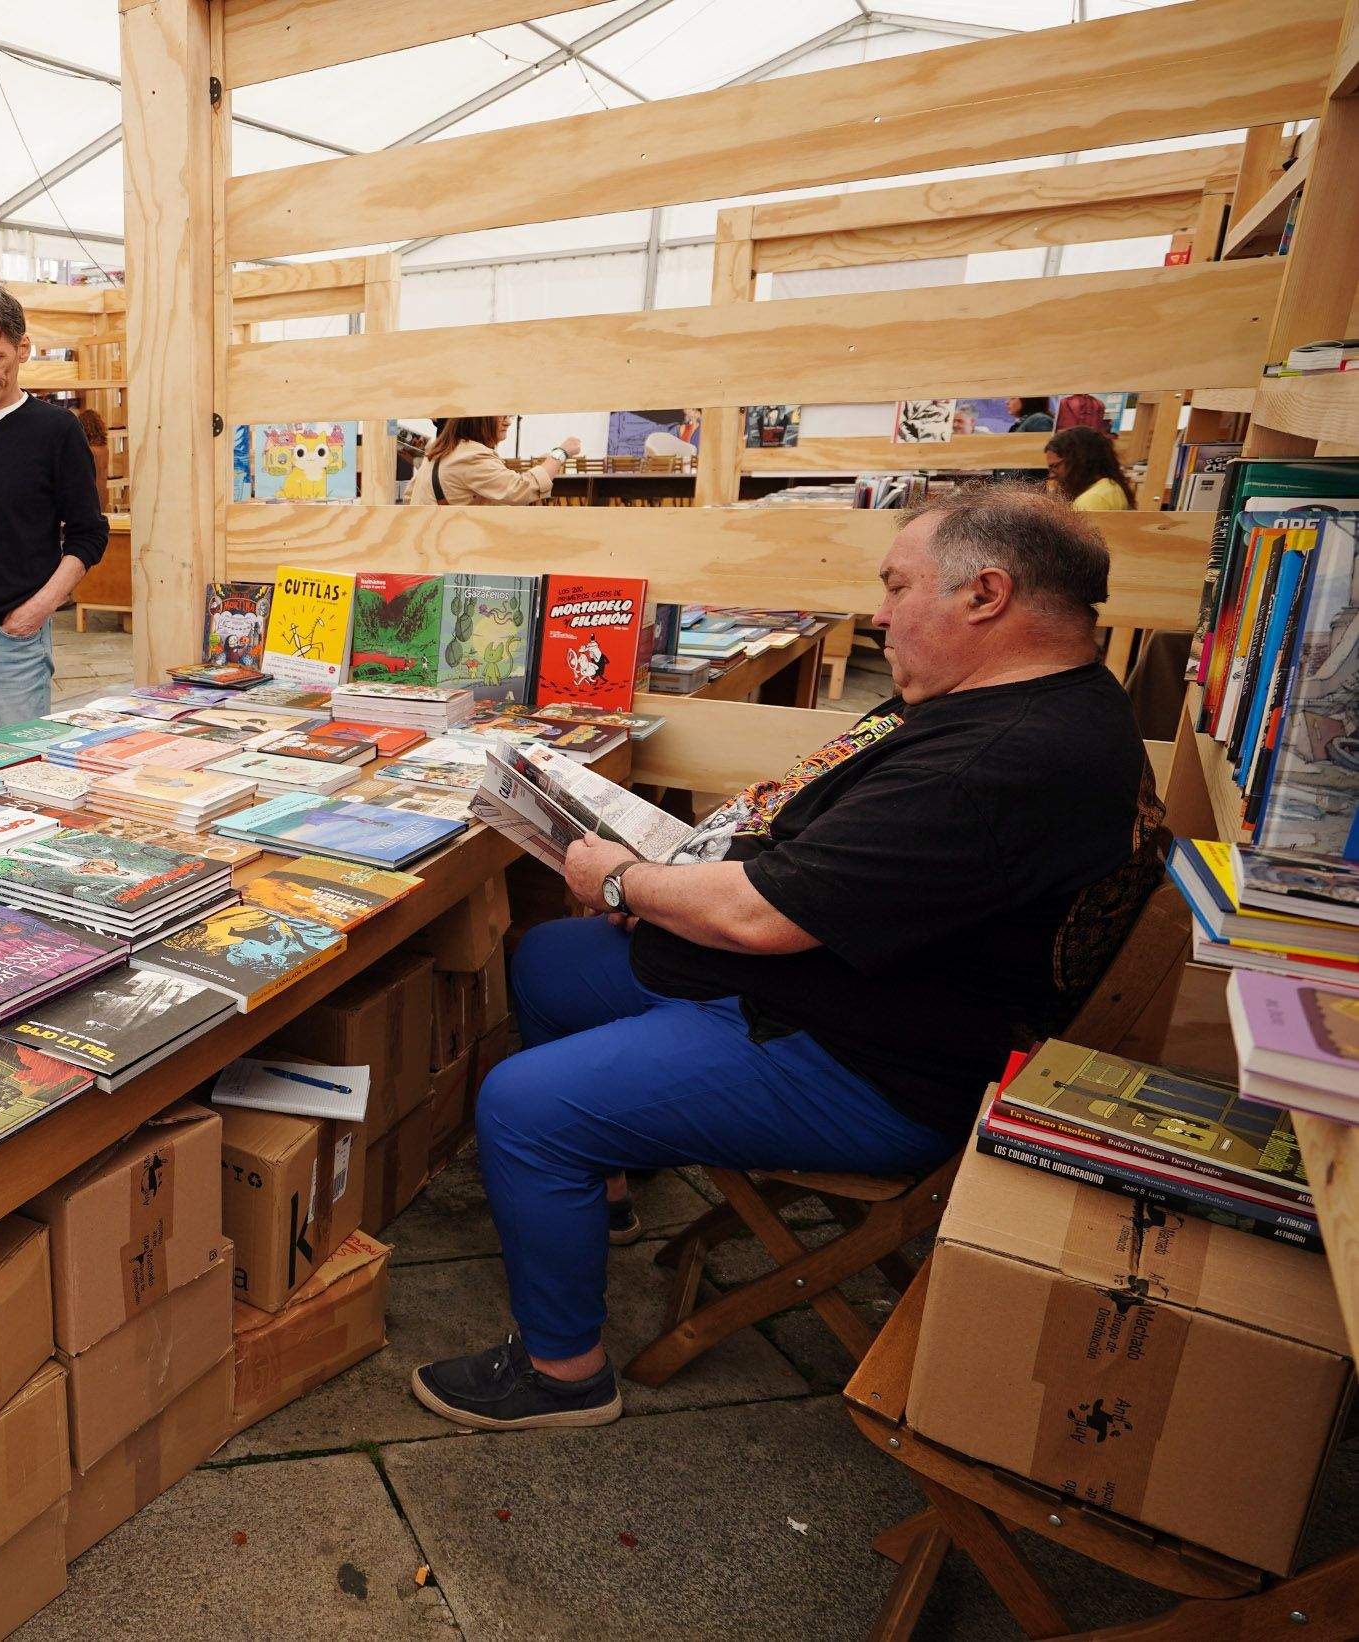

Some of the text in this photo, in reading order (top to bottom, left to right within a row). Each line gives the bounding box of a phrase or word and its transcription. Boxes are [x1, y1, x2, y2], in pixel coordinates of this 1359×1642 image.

[285, 579, 340, 600] CUTTLAS
[550, 599, 633, 617] MORTADELO
[591, 590, 612, 598] CASOS
[570, 613, 633, 628] FILEMÓN
[275, 969, 303, 990] ENSALADA
[309, 957, 322, 969] NIZA
[15, 1024, 58, 1039] BAJO
[57, 1036, 80, 1048] LA
[80, 1043, 116, 1062] PIEL
[1009, 1108, 1022, 1120] Un
[1023, 1113, 1056, 1129] verano
[1058, 1121, 1102, 1142] insolente
[1107, 1138, 1131, 1152] Rubén
[1133, 1144, 1166, 1162] Pellejero
[1171, 1156, 1193, 1169] Denis
[994, 1144, 1007, 1156] LOS
[1008, 1148, 1038, 1166] COLORES
[1039, 1157, 1052, 1169] DEL
[1052, 1160, 1105, 1185] UNDERGROUND
[1122, 1183, 1139, 1194] Joan
[1148, 1189, 1166, 1201] Luna
[1273, 1229, 1306, 1244] ASTIBERRI
[1006, 1135, 1027, 1147] largo
[1028, 1140, 1061, 1158] silencio
[1276, 1215, 1312, 1232] ASTIBERRI
[1086, 1307, 1110, 1360] Distribución
[1105, 1313, 1127, 1353] Grupo de
[1127, 1307, 1156, 1360] Machado
